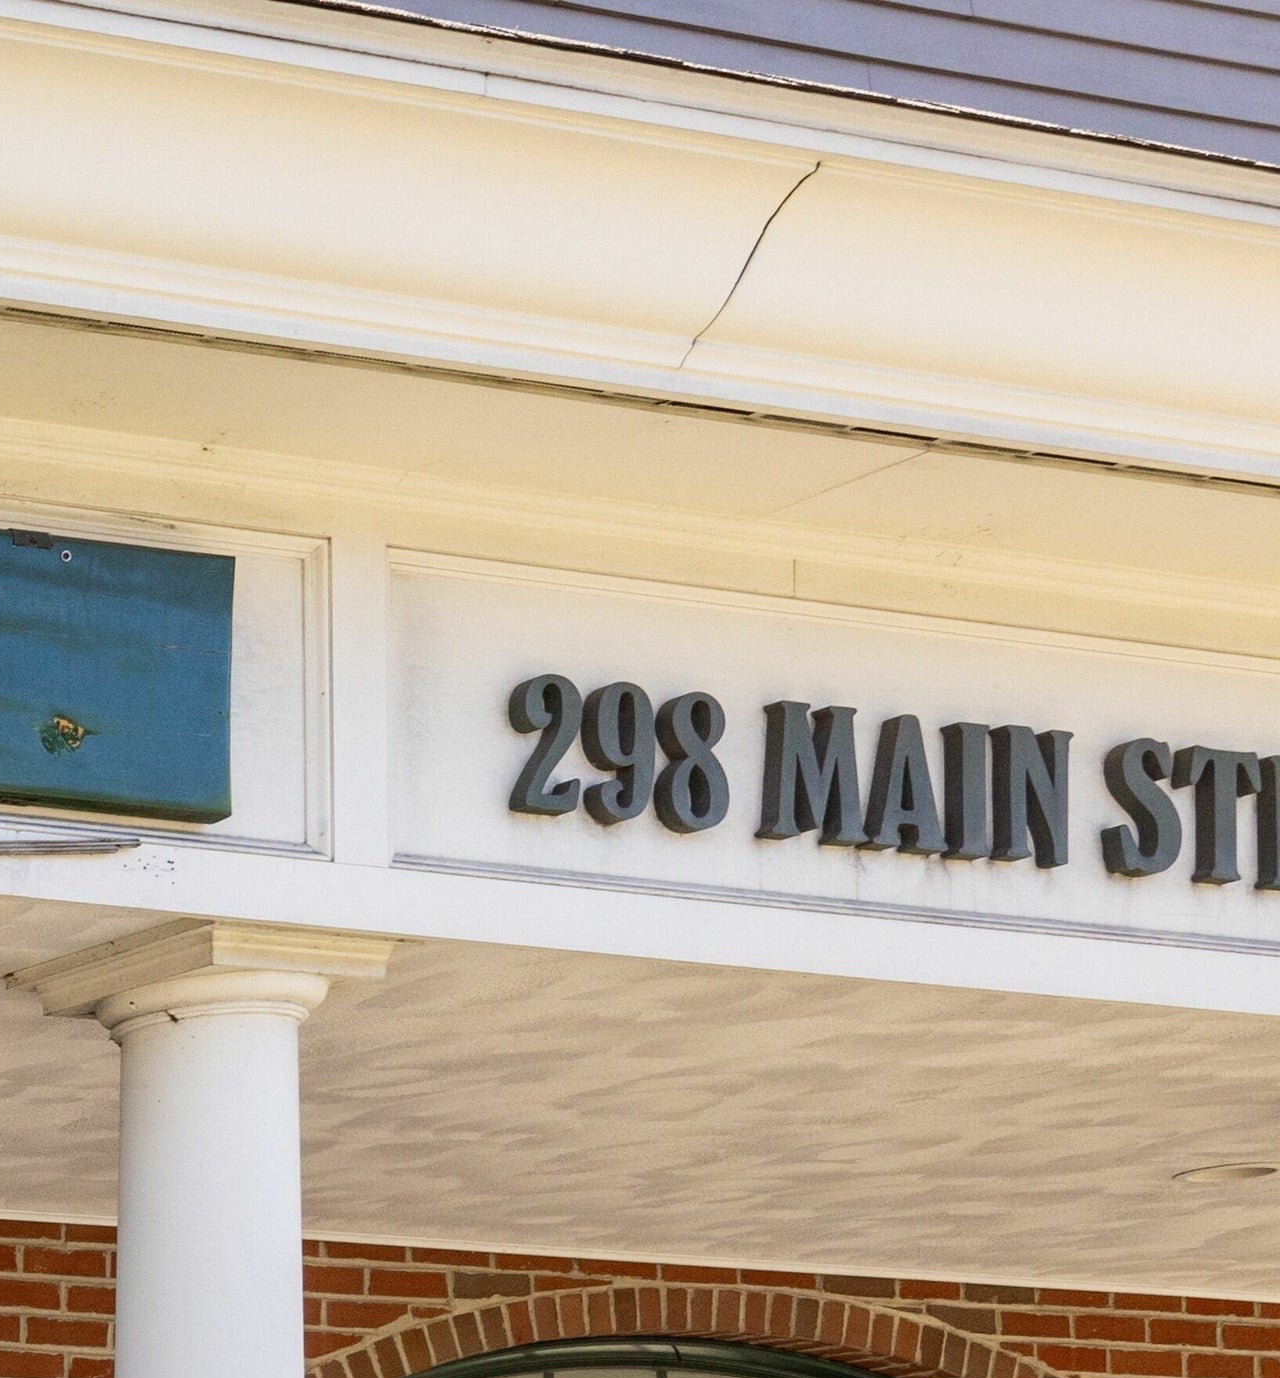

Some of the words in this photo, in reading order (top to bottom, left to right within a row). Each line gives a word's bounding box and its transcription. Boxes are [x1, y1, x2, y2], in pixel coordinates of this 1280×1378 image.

[507, 673, 730, 835] 298
[755, 700, 1075, 869] MAIN
[1100, 737, 1280, 892] ST
